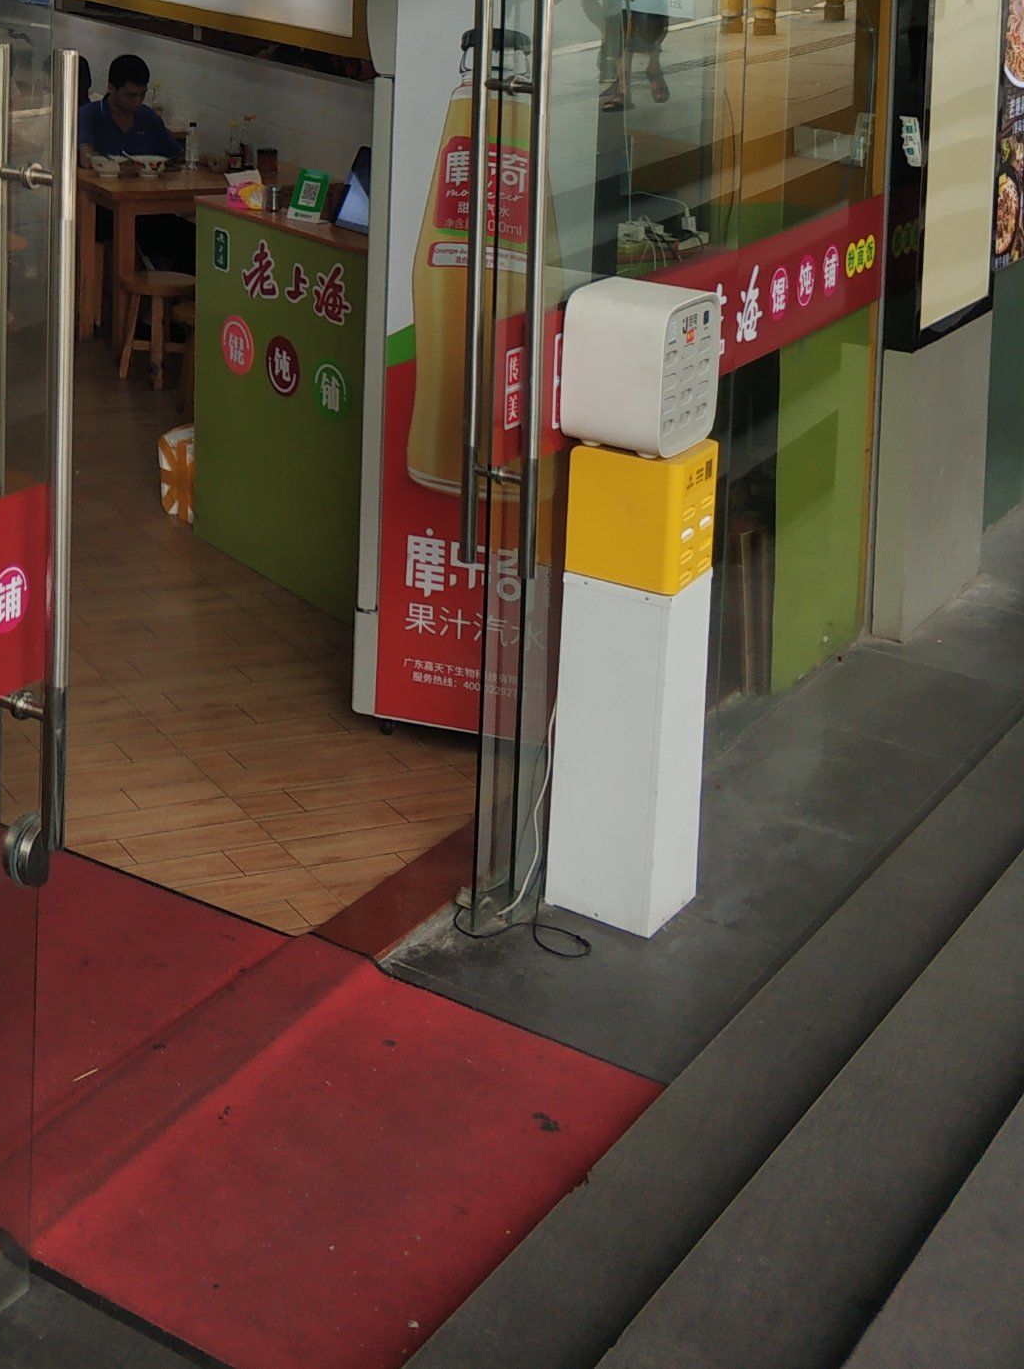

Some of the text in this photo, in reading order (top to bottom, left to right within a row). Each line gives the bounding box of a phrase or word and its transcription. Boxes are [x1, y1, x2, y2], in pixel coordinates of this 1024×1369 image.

[445, 145, 529, 193] 摩奇
[243, 239, 352, 325] 老上海
[771, 253, 839, 314] 馄饨铺
[229, 333, 340, 413] 馄饨铺
